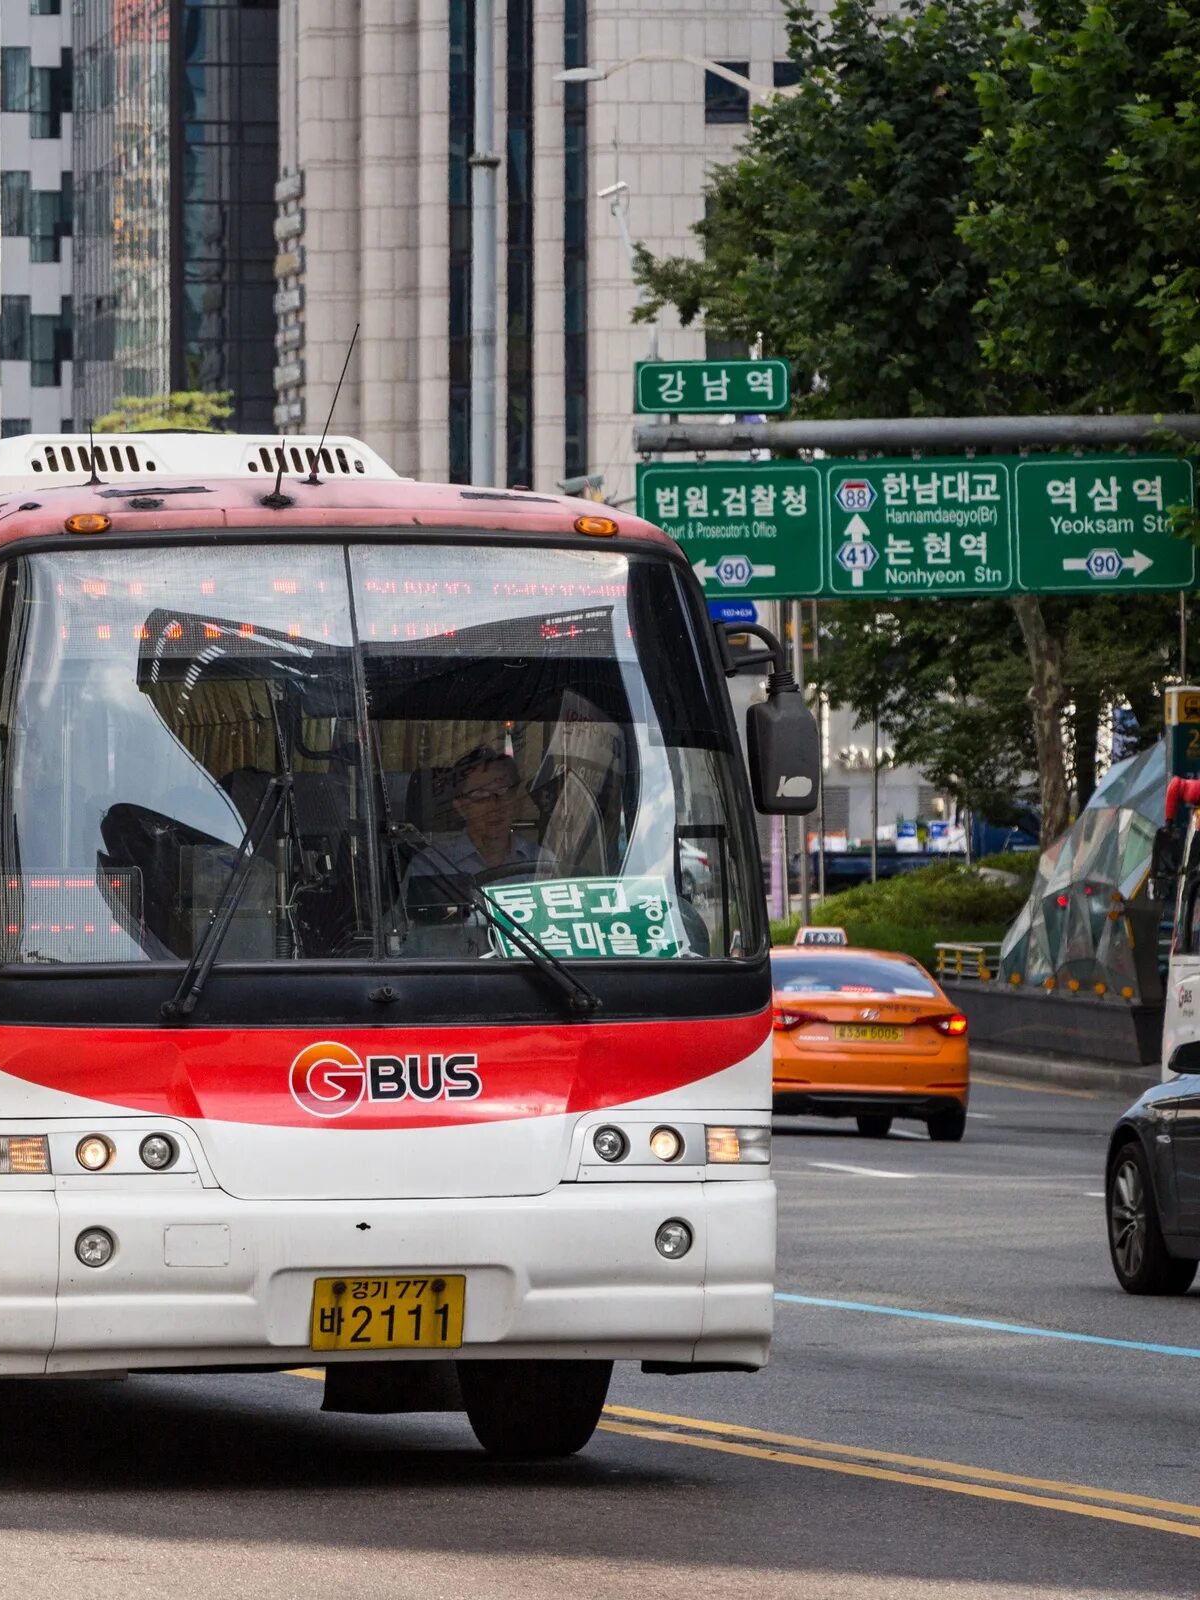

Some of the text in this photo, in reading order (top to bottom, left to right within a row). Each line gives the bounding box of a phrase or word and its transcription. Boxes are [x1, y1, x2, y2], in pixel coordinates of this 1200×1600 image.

[657, 367, 774, 404] 강남역
[845, 489, 868, 508] 88
[881, 470, 1001, 507] 한남대교
[1046, 475, 1164, 515] 역삼역
[885, 505, 999, 528] Hannamdaegyo(Br)
[1050, 514, 1135, 536] Yeoksam
[662, 520, 778, 540] Court & Prosecutor's Office
[845, 546, 869, 565] 41
[884, 531, 988, 566] 논현역
[723, 562, 746, 581] 90
[1093, 555, 1116, 574] 90
[885, 565, 1003, 588] Nonhyeon Stn
[493, 881, 632, 924] 동탄고
[808, 932, 841, 944] TAXI
[351, 1279, 429, 1300] 경기 77
[319, 1303, 450, 1343] 바 2111
